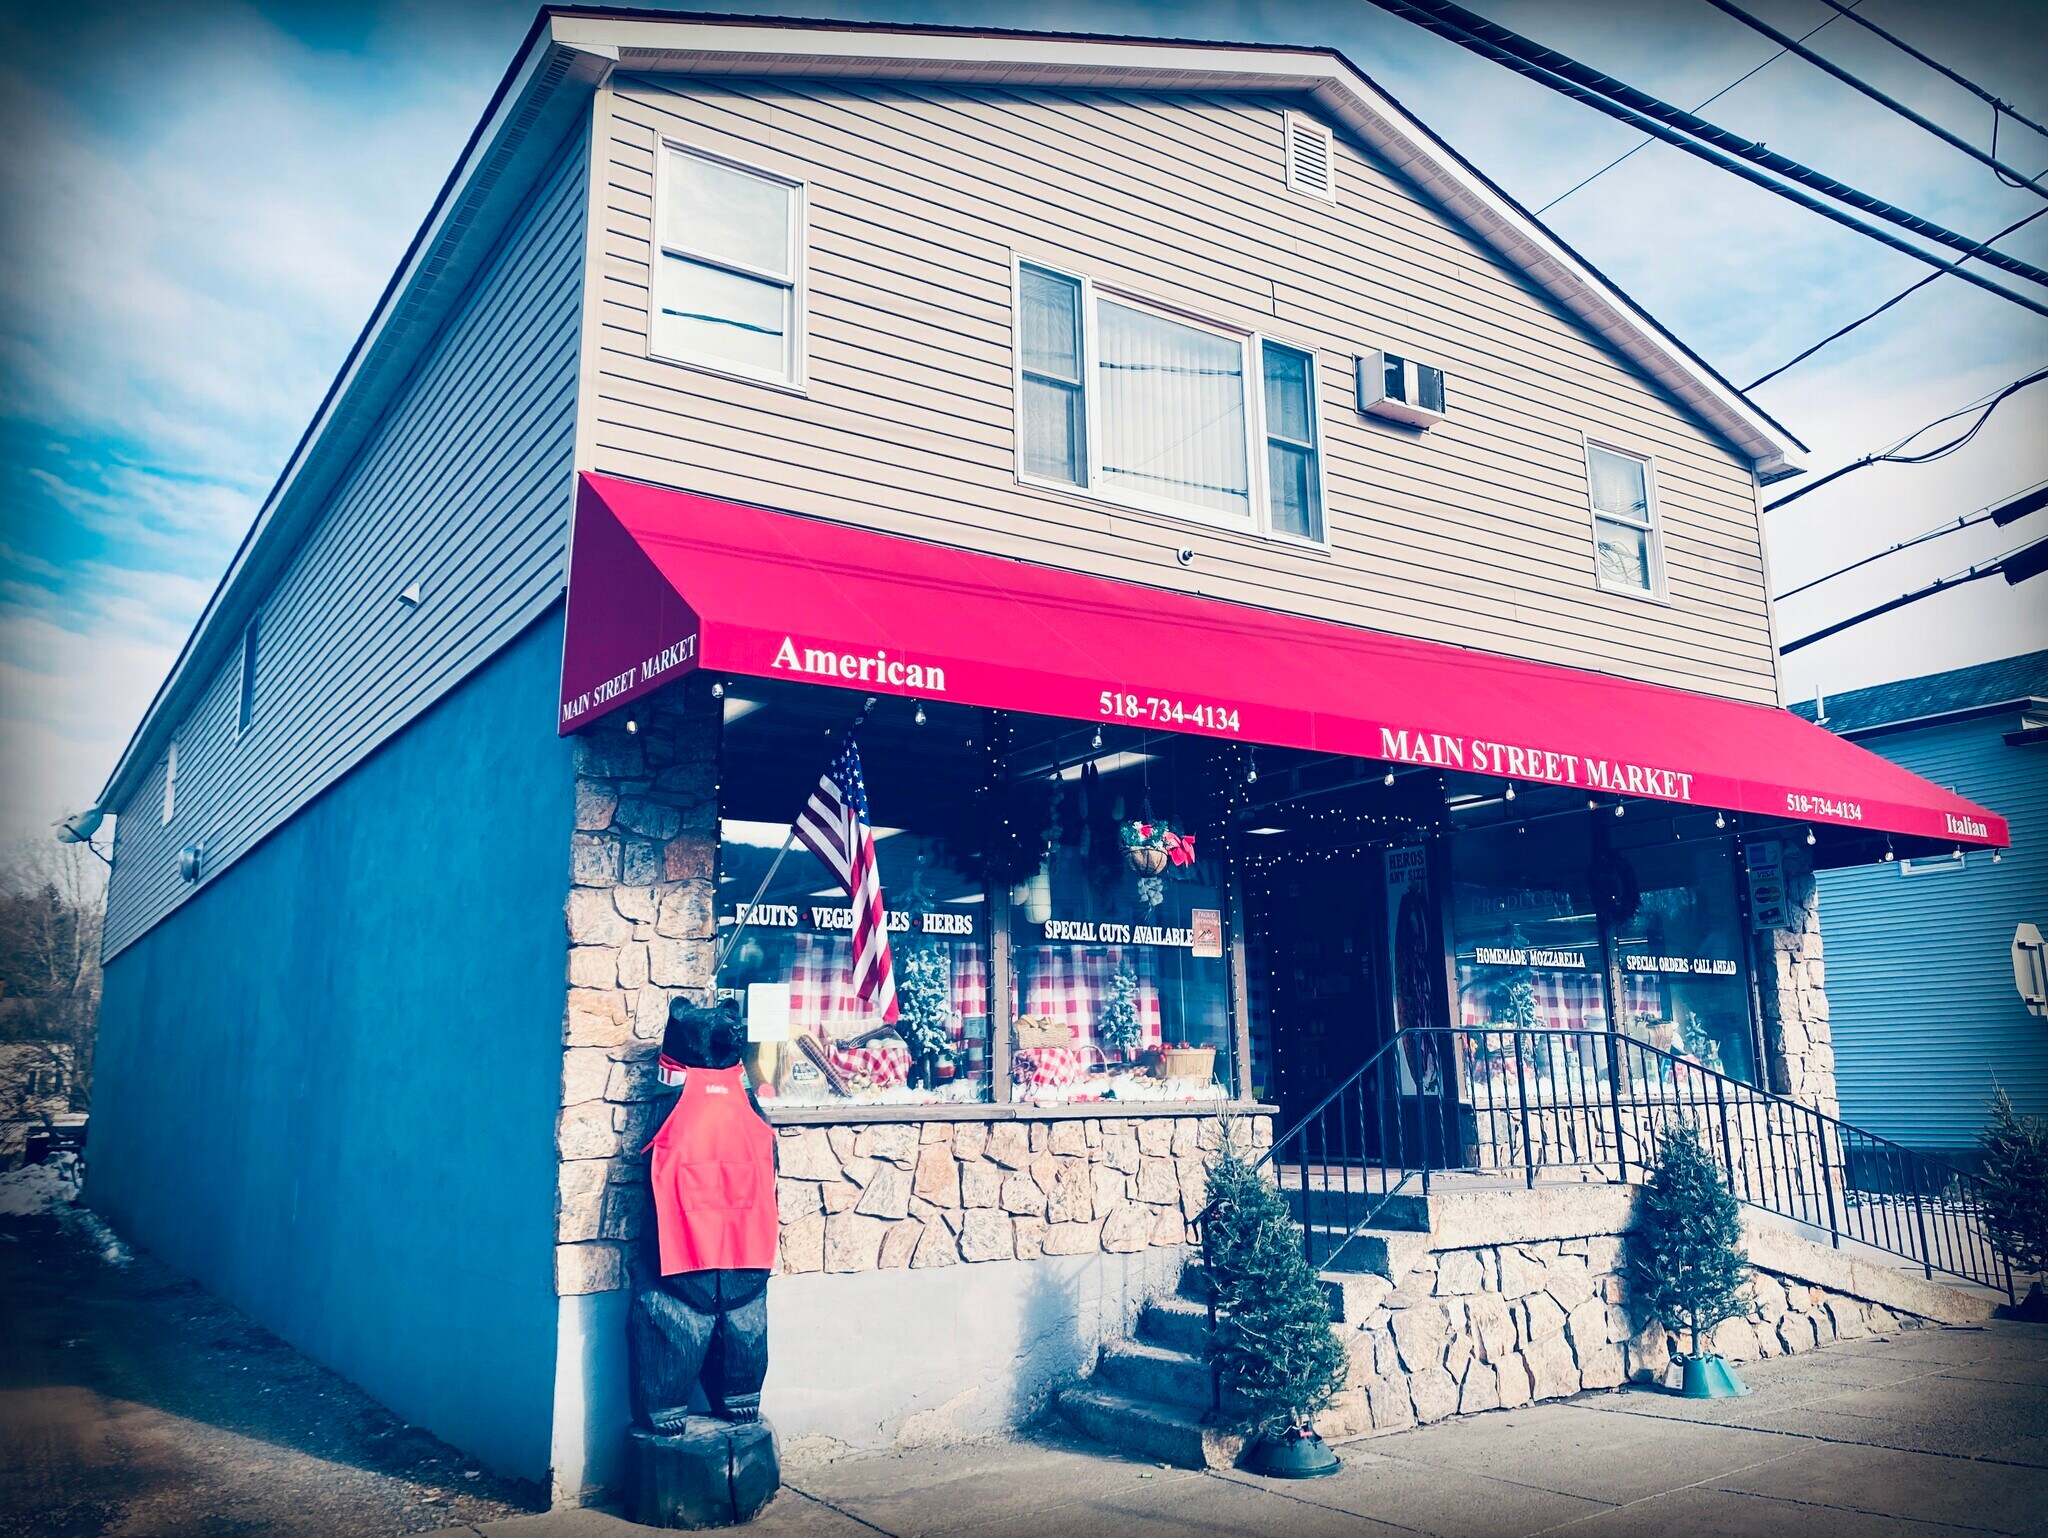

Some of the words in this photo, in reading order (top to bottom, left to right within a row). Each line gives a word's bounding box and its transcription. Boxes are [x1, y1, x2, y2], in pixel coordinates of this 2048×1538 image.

[771, 635, 946, 692] American
[561, 692, 591, 723] MAIN
[592, 667, 636, 708] STREET
[640, 633, 697, 681] MARKET
[1100, 691, 1240, 732] 518-734-4134
[1379, 727, 1464, 767] MAIN
[1471, 738, 1579, 784] STREET
[1584, 757, 1694, 801] MARKET
[1786, 793, 1863, 821] 518-734-4134
[1945, 813, 1988, 838] Italian
[1389, 850, 1425, 869] HEROS
[734, 903, 798, 927] FRUITS
[811, 906, 910, 932] VEGELES
[921, 913, 973, 935] HERBS
[1044, 919, 1097, 942] SPECIAL
[1099, 923, 1131, 944] CUTS
[1132, 925, 1194, 947] AVAILABLE
[1475, 947, 1528, 966] HOMEMADE
[1529, 949, 1586, 968] MOZZARELLA
[1627, 956, 1658, 971] SPECIAL
[1659, 956, 1689, 973] ORDERS
[1693, 959, 1712, 974] CALL
[1712, 960, 1737, 975] AHEAD
